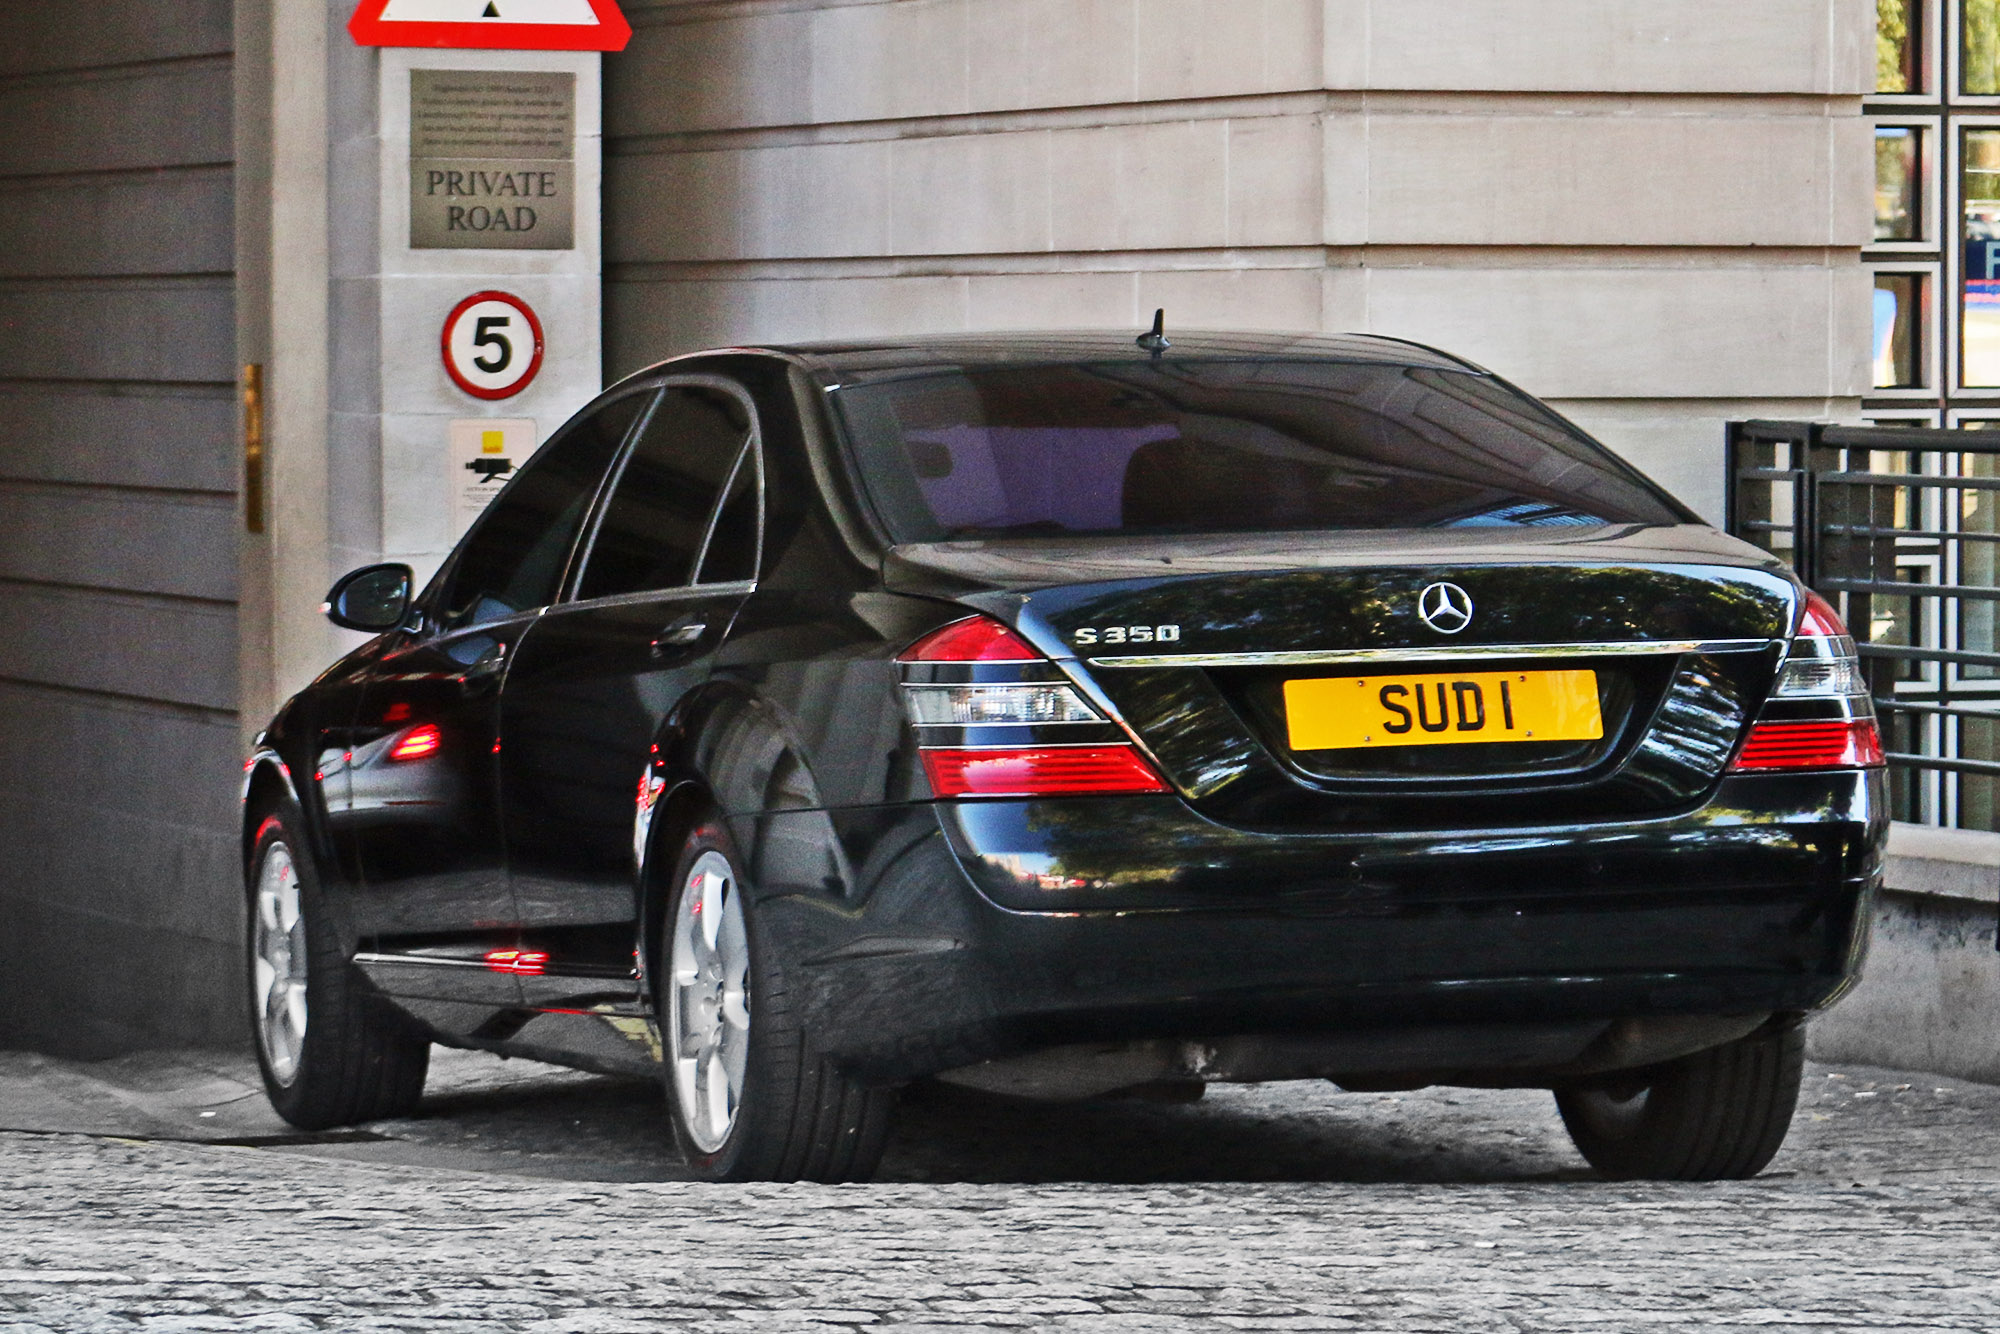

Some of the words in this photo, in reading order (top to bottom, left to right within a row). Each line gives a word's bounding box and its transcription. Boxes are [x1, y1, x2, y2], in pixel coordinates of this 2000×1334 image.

[426, 170, 557, 197] PRIVATE
[448, 205, 537, 231] ROAD
[473, 316, 512, 374] 5
[1379, 681, 1486, 734] SUD
